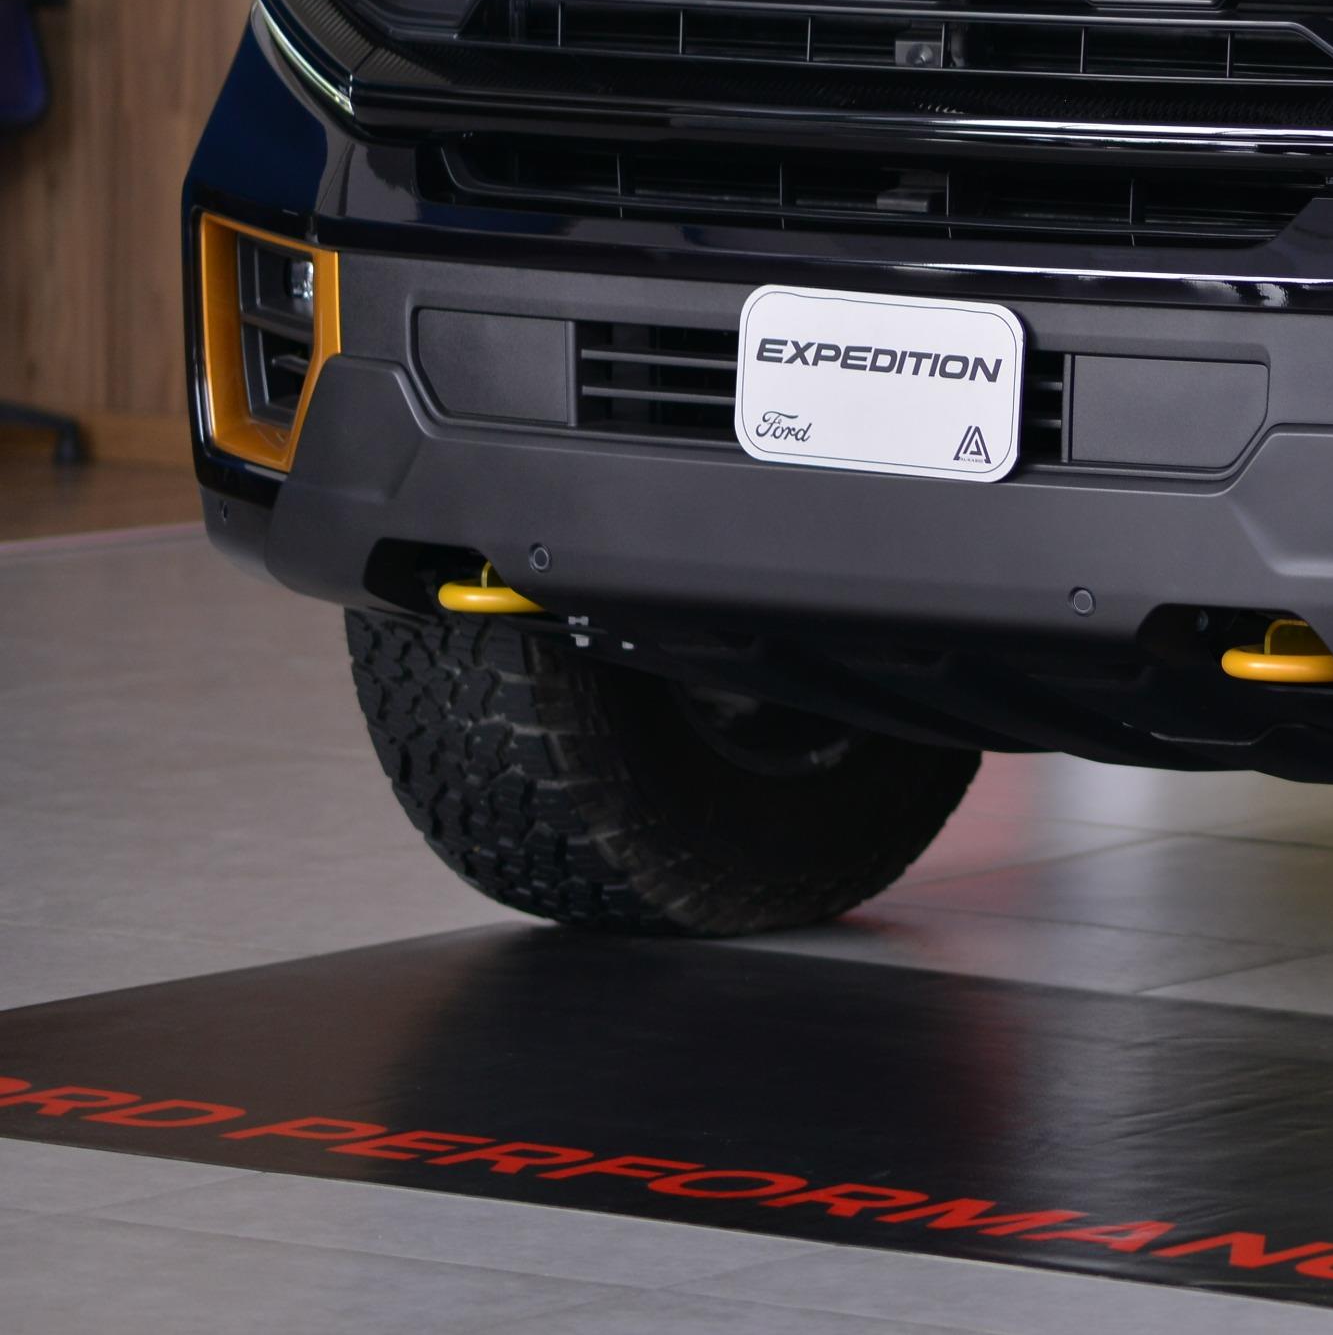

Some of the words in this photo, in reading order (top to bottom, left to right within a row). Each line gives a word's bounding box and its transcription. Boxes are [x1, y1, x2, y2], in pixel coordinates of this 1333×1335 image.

[756, 337, 1002, 383] EXPEDITION
[755, 410, 812, 442] Ford
[0, 1076, 247, 1128] RD
